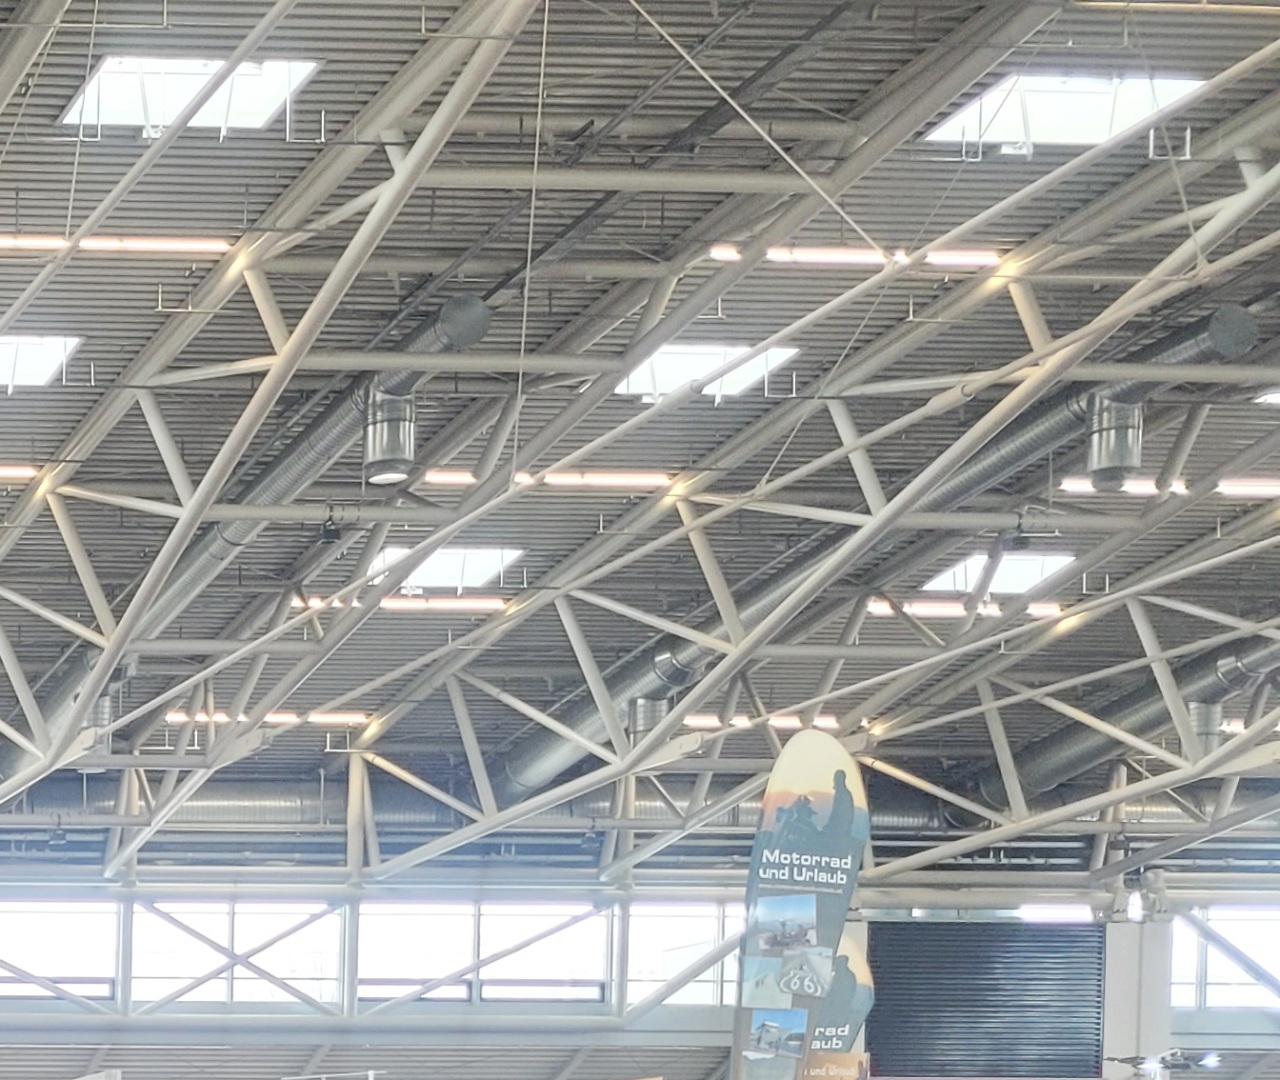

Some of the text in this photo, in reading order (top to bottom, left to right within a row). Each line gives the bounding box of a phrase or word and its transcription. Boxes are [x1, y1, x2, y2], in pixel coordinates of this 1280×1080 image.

[761, 848, 852, 870] Motorrad
[758, 866, 847, 885] und Urlaub
